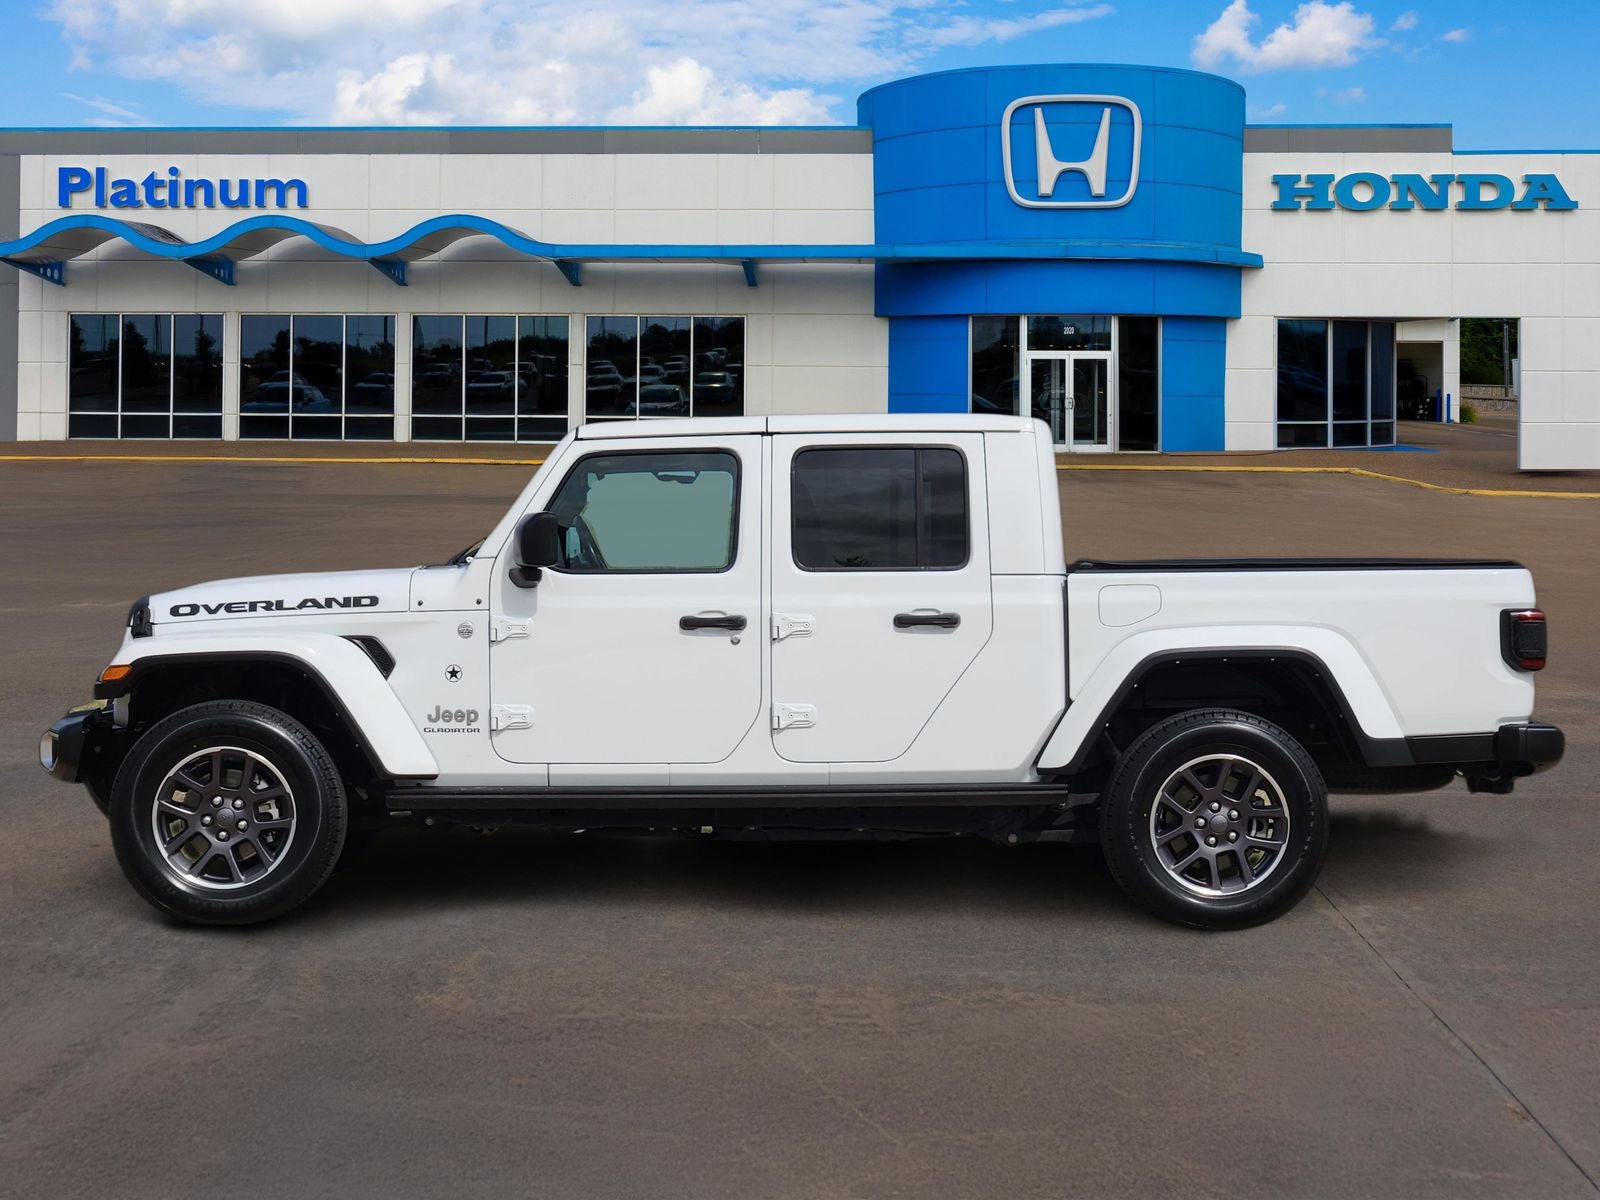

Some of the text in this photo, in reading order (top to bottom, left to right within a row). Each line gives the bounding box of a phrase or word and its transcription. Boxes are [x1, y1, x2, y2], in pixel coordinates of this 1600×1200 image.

[58, 166, 309, 208] Platinum
[1271, 172, 1579, 212] HONDA
[169, 595, 380, 617] OVERLAND
[427, 705, 479, 726] Jeep
